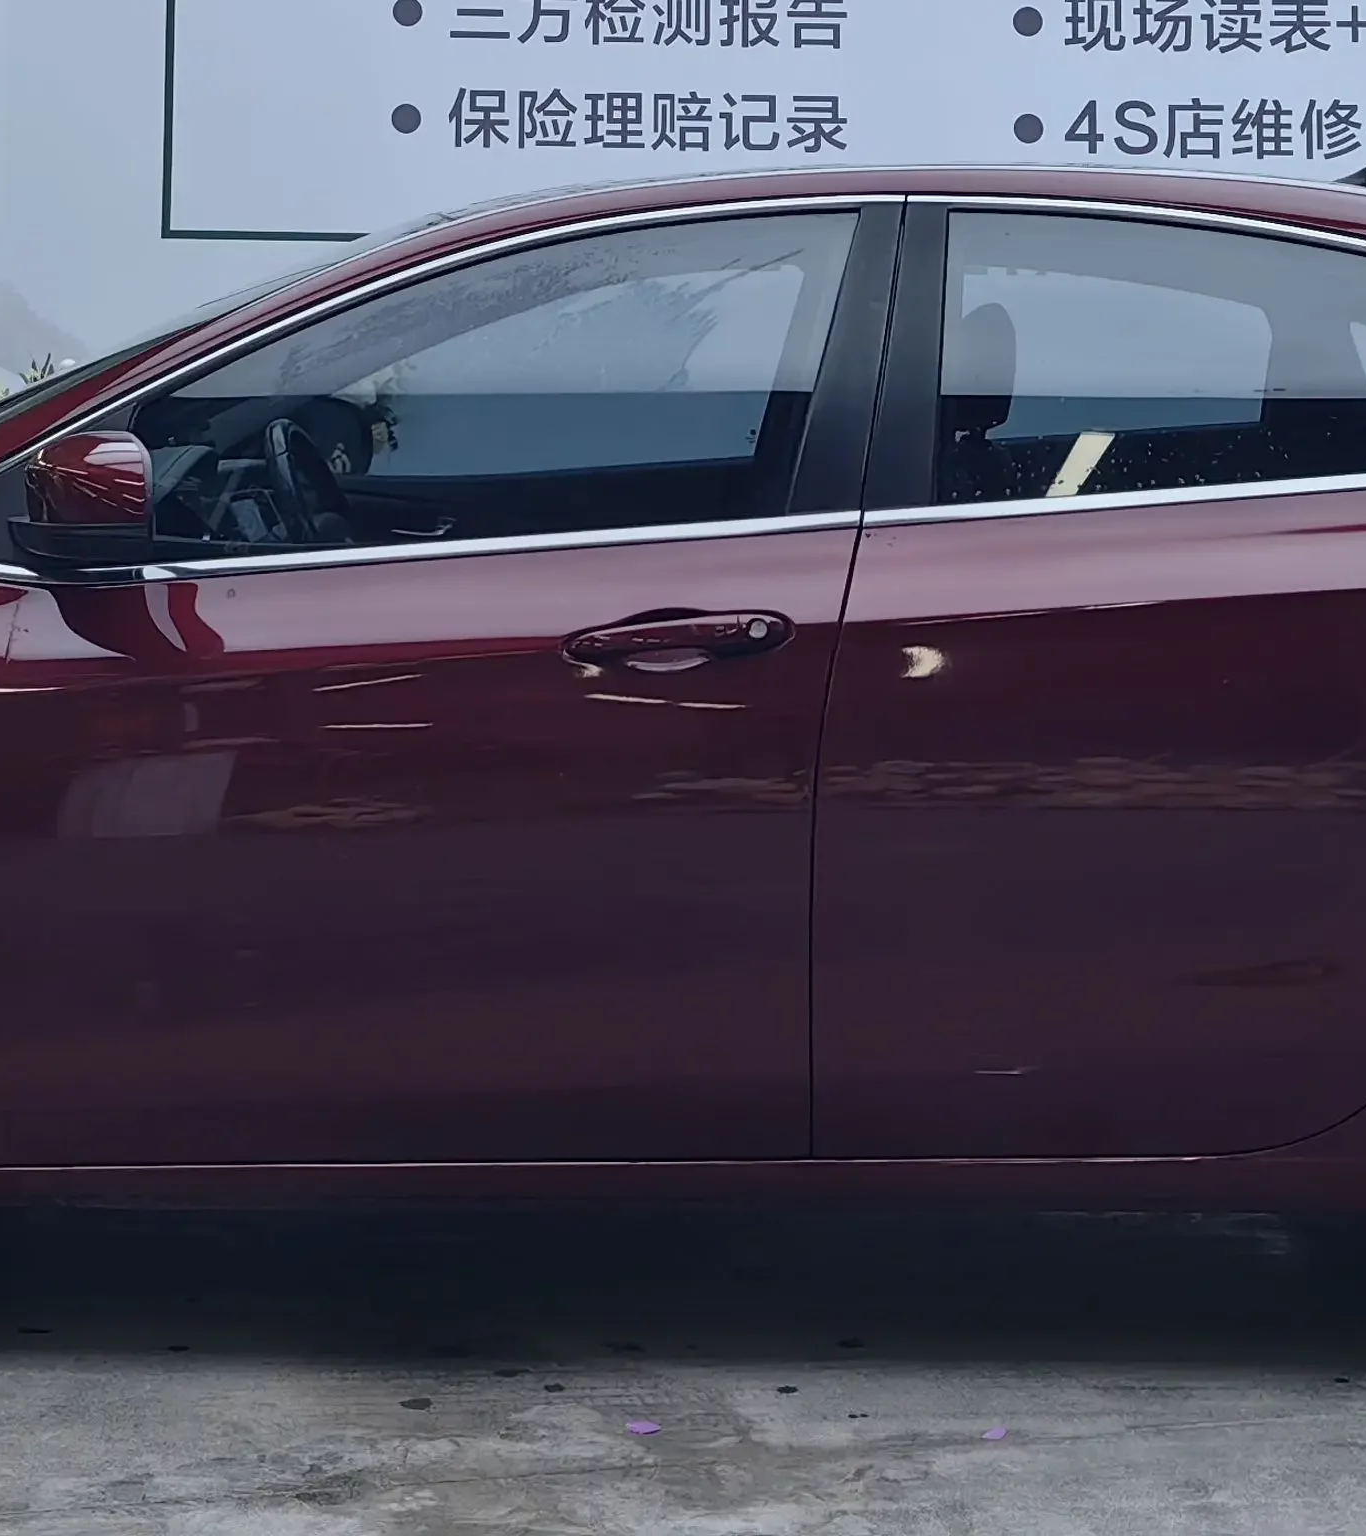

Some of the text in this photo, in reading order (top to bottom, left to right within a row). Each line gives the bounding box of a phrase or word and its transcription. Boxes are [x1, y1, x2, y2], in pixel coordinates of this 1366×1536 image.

[448, 87, 848, 153] 保险理赔记录
